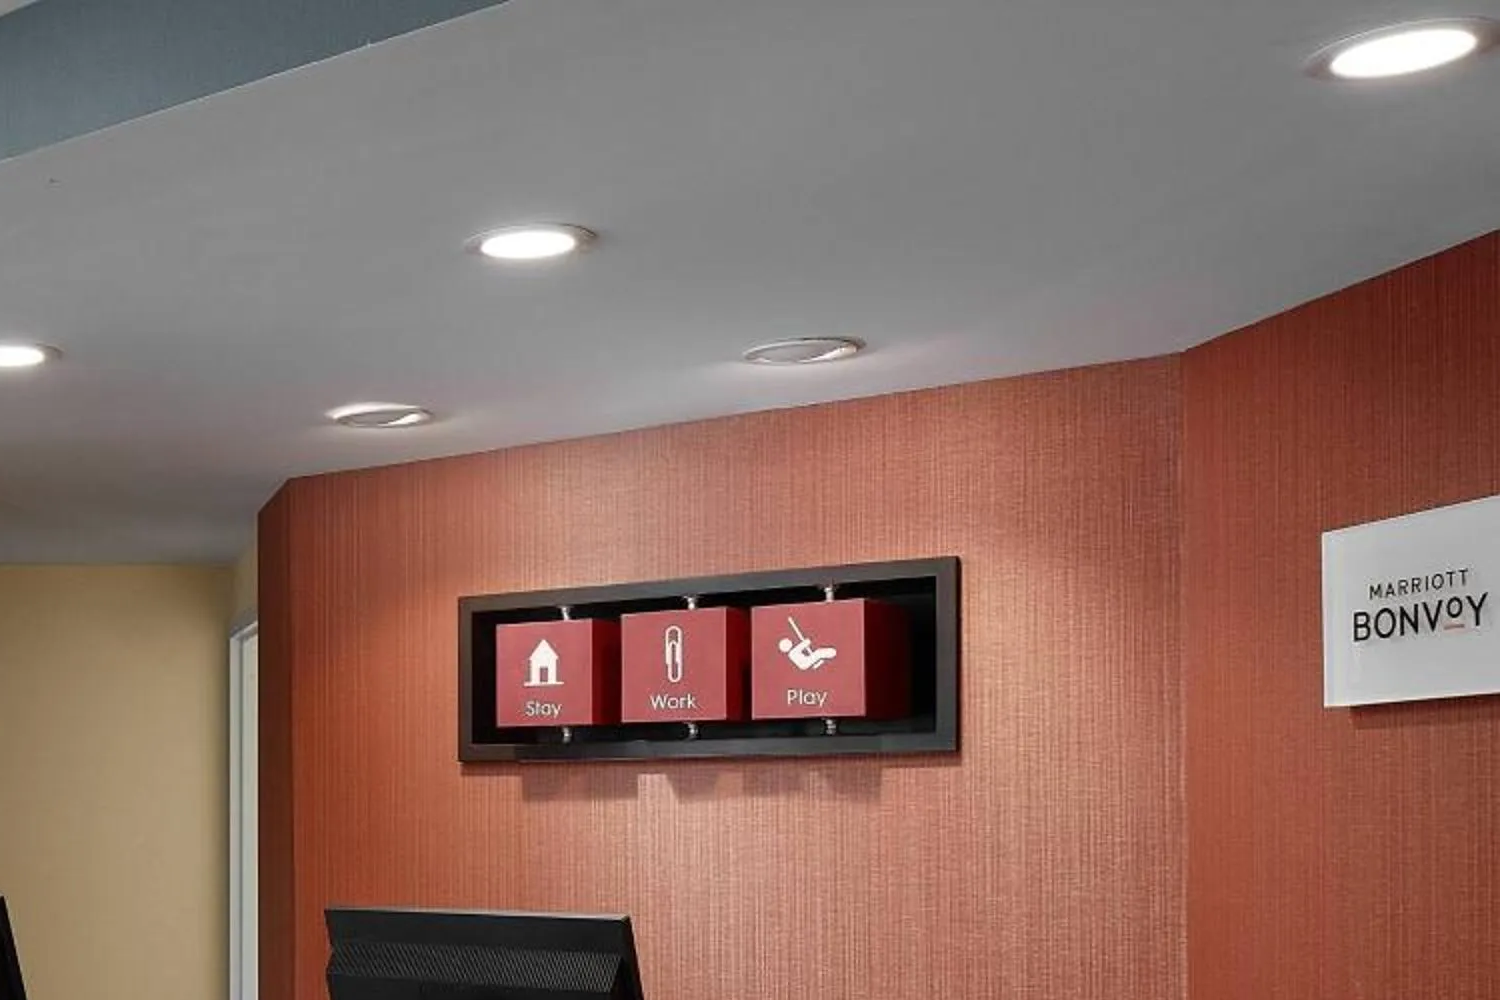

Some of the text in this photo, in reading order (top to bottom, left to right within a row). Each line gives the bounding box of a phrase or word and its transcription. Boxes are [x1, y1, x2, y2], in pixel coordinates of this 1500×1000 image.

[1369, 568, 1469, 600] MARRIOTT
[1352, 592, 1489, 642] BONVOY
[650, 693, 697, 710] Work
[786, 689, 828, 708] Play
[524, 700, 563, 719] Stay
